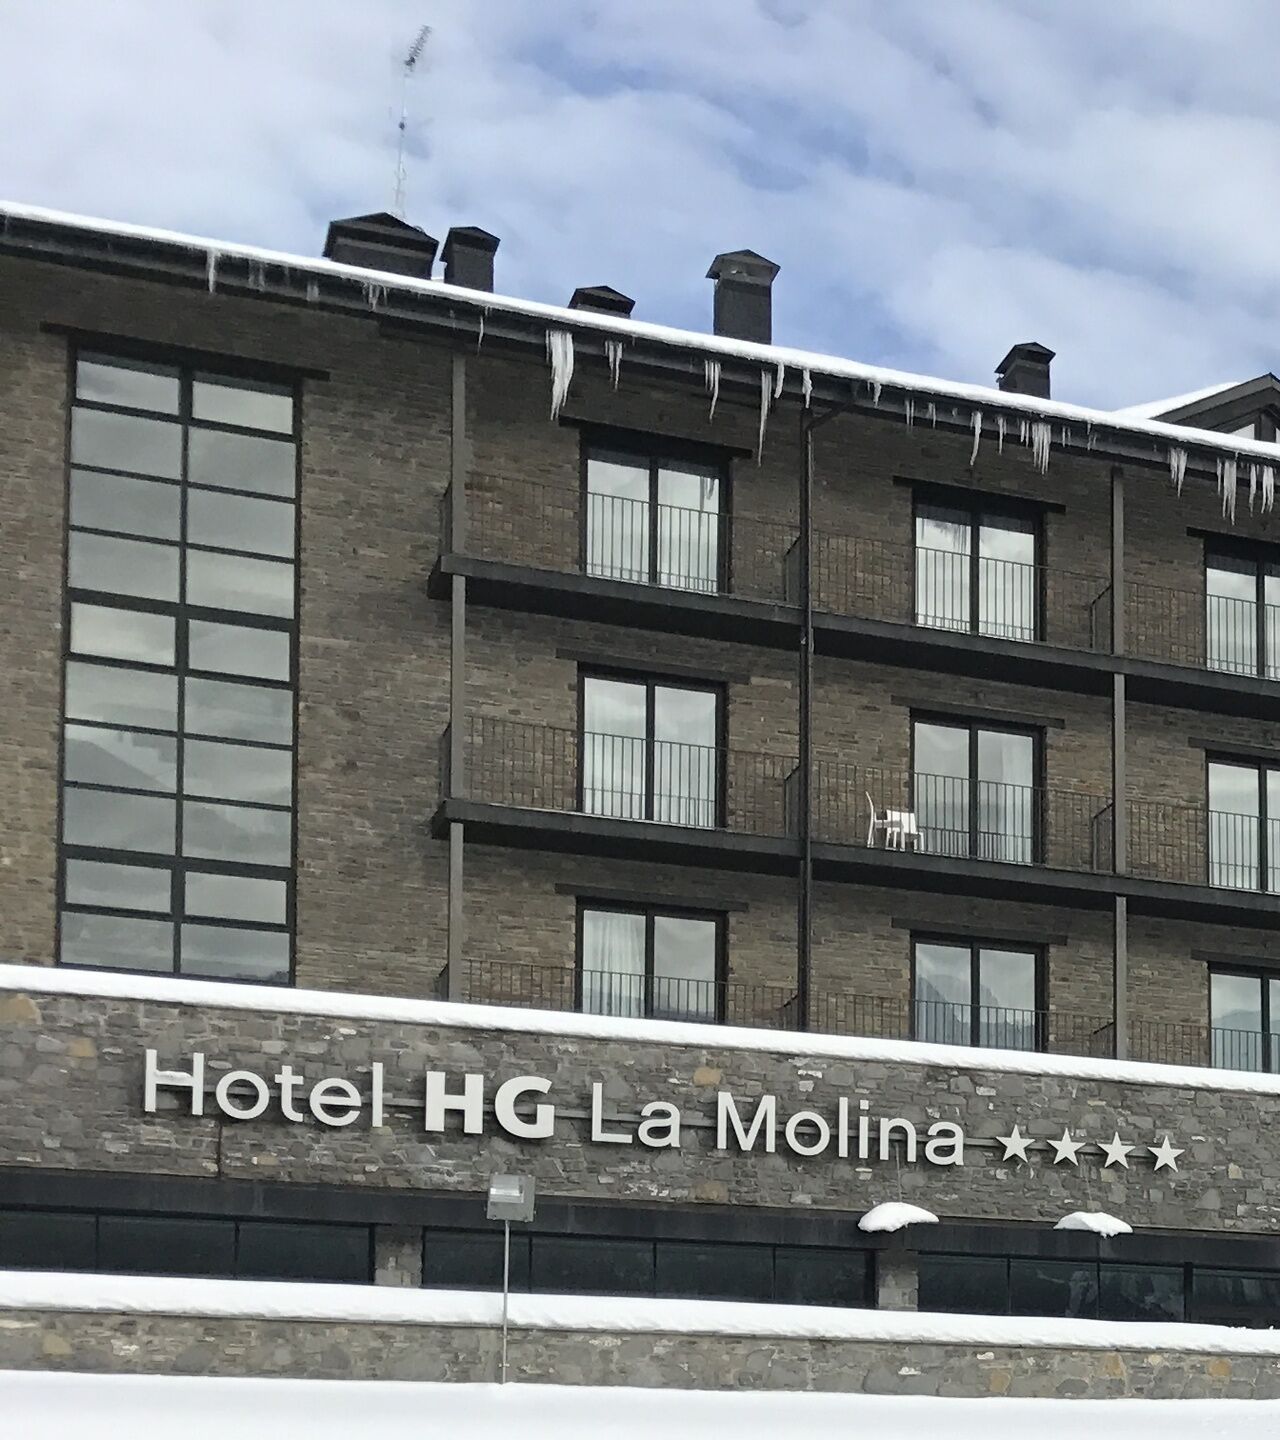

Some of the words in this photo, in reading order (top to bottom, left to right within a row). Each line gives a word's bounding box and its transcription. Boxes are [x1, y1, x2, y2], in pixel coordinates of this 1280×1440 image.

[144, 1048, 385, 1129] Hotel
[424, 1071, 556, 1140] HG
[593, 1082, 683, 1147] La
[717, 1091, 966, 1168] Molina
